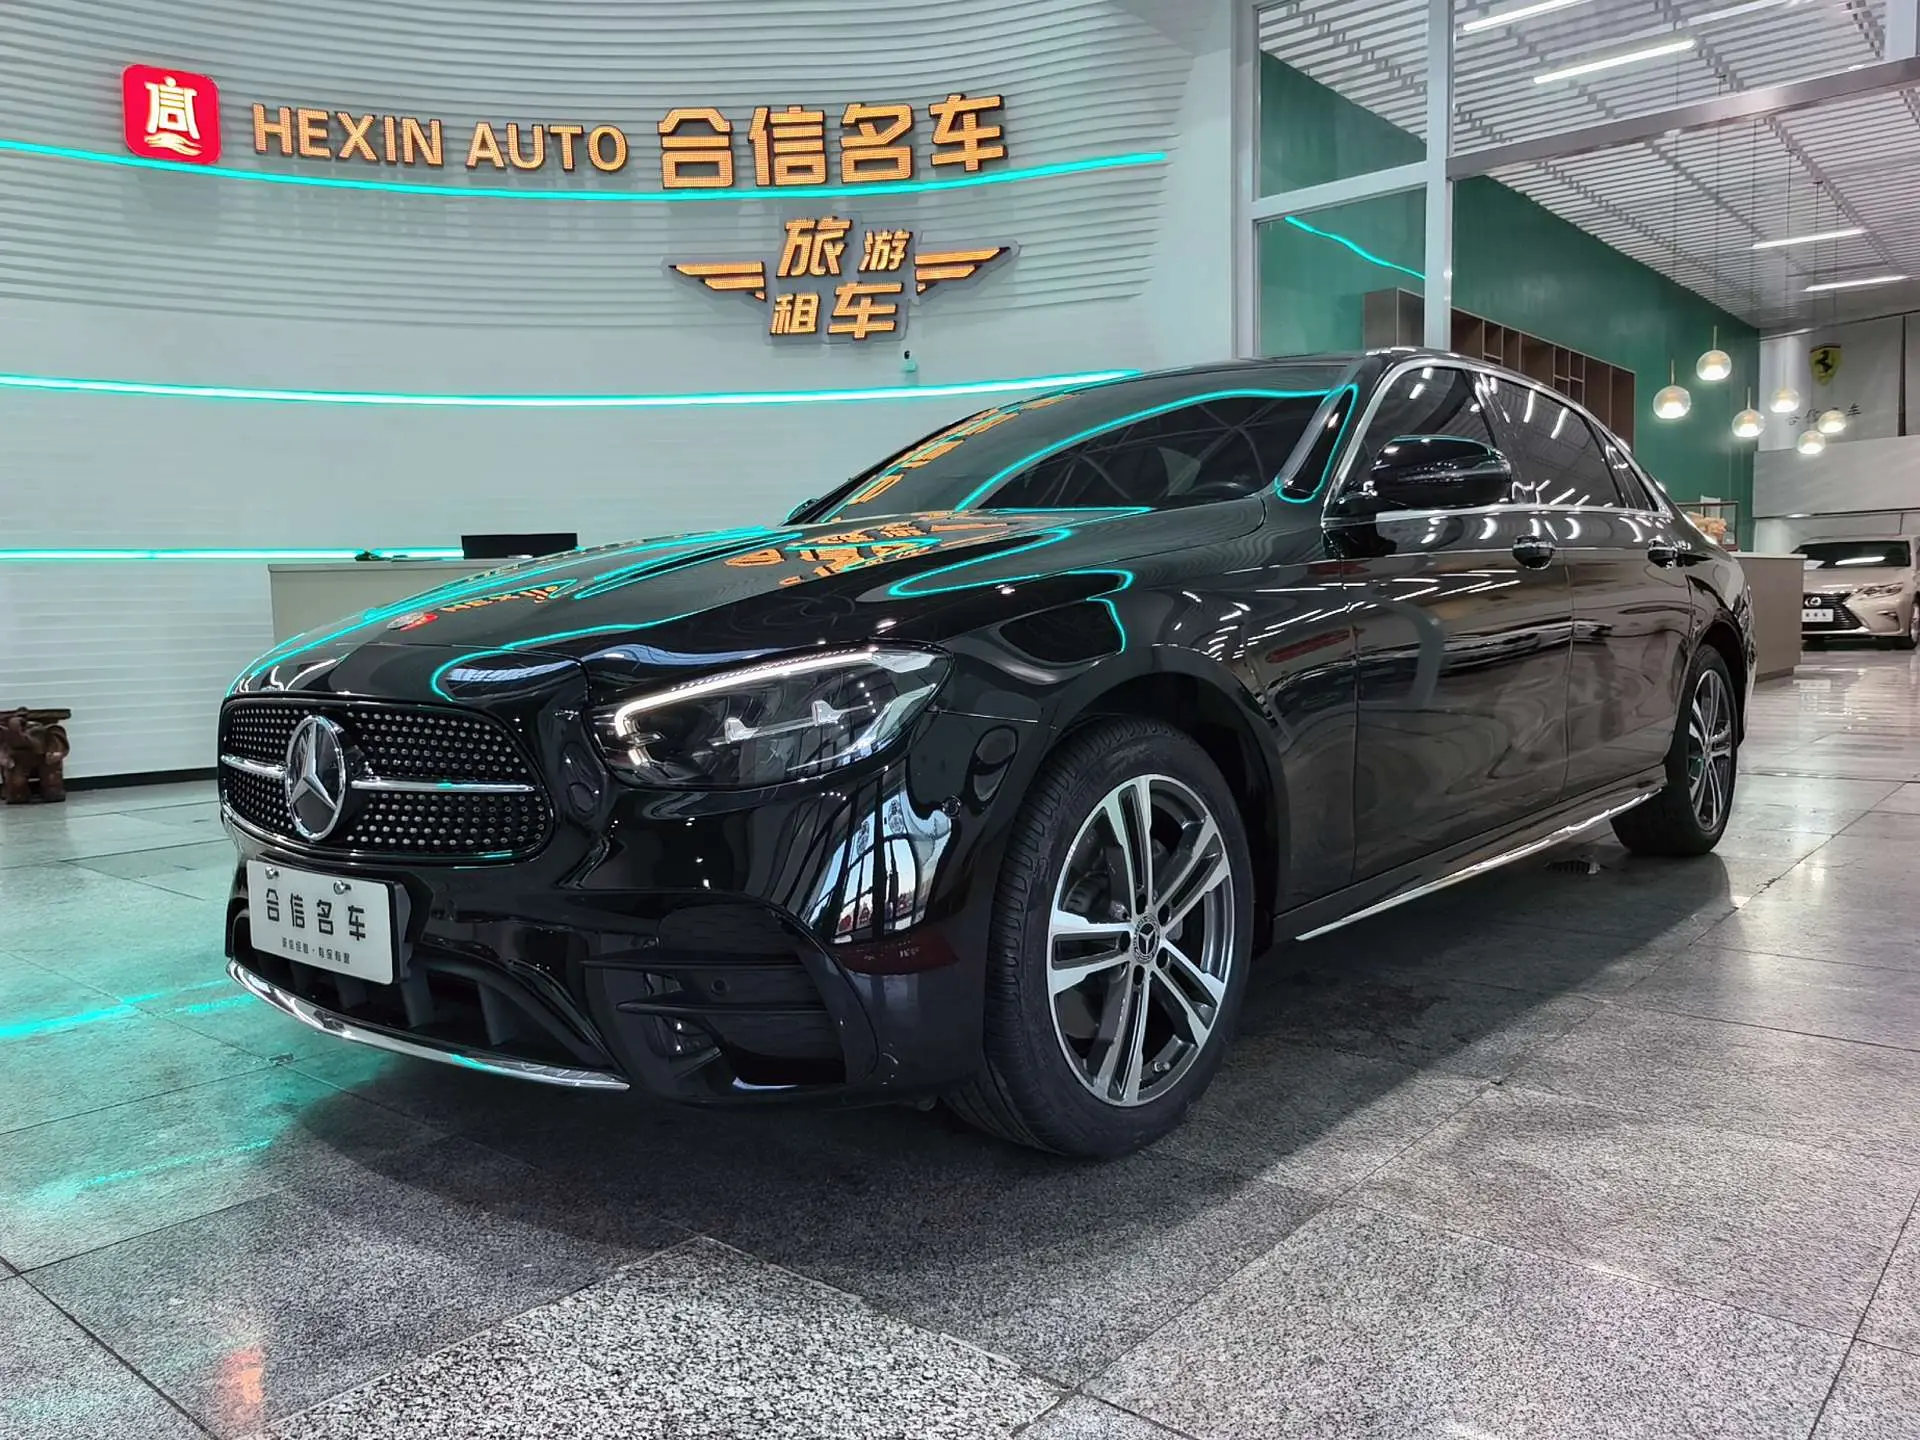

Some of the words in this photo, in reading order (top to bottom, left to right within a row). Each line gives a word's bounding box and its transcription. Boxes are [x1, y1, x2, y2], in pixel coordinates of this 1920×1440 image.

[251, 102, 444, 166] HEXIN
[465, 121, 629, 172] AUTO
[657, 94, 1008, 189] 合信名车
[776, 216, 914, 277] 旅游
[769, 281, 903, 340] 租车
[266, 888, 366, 941] 合信名车
